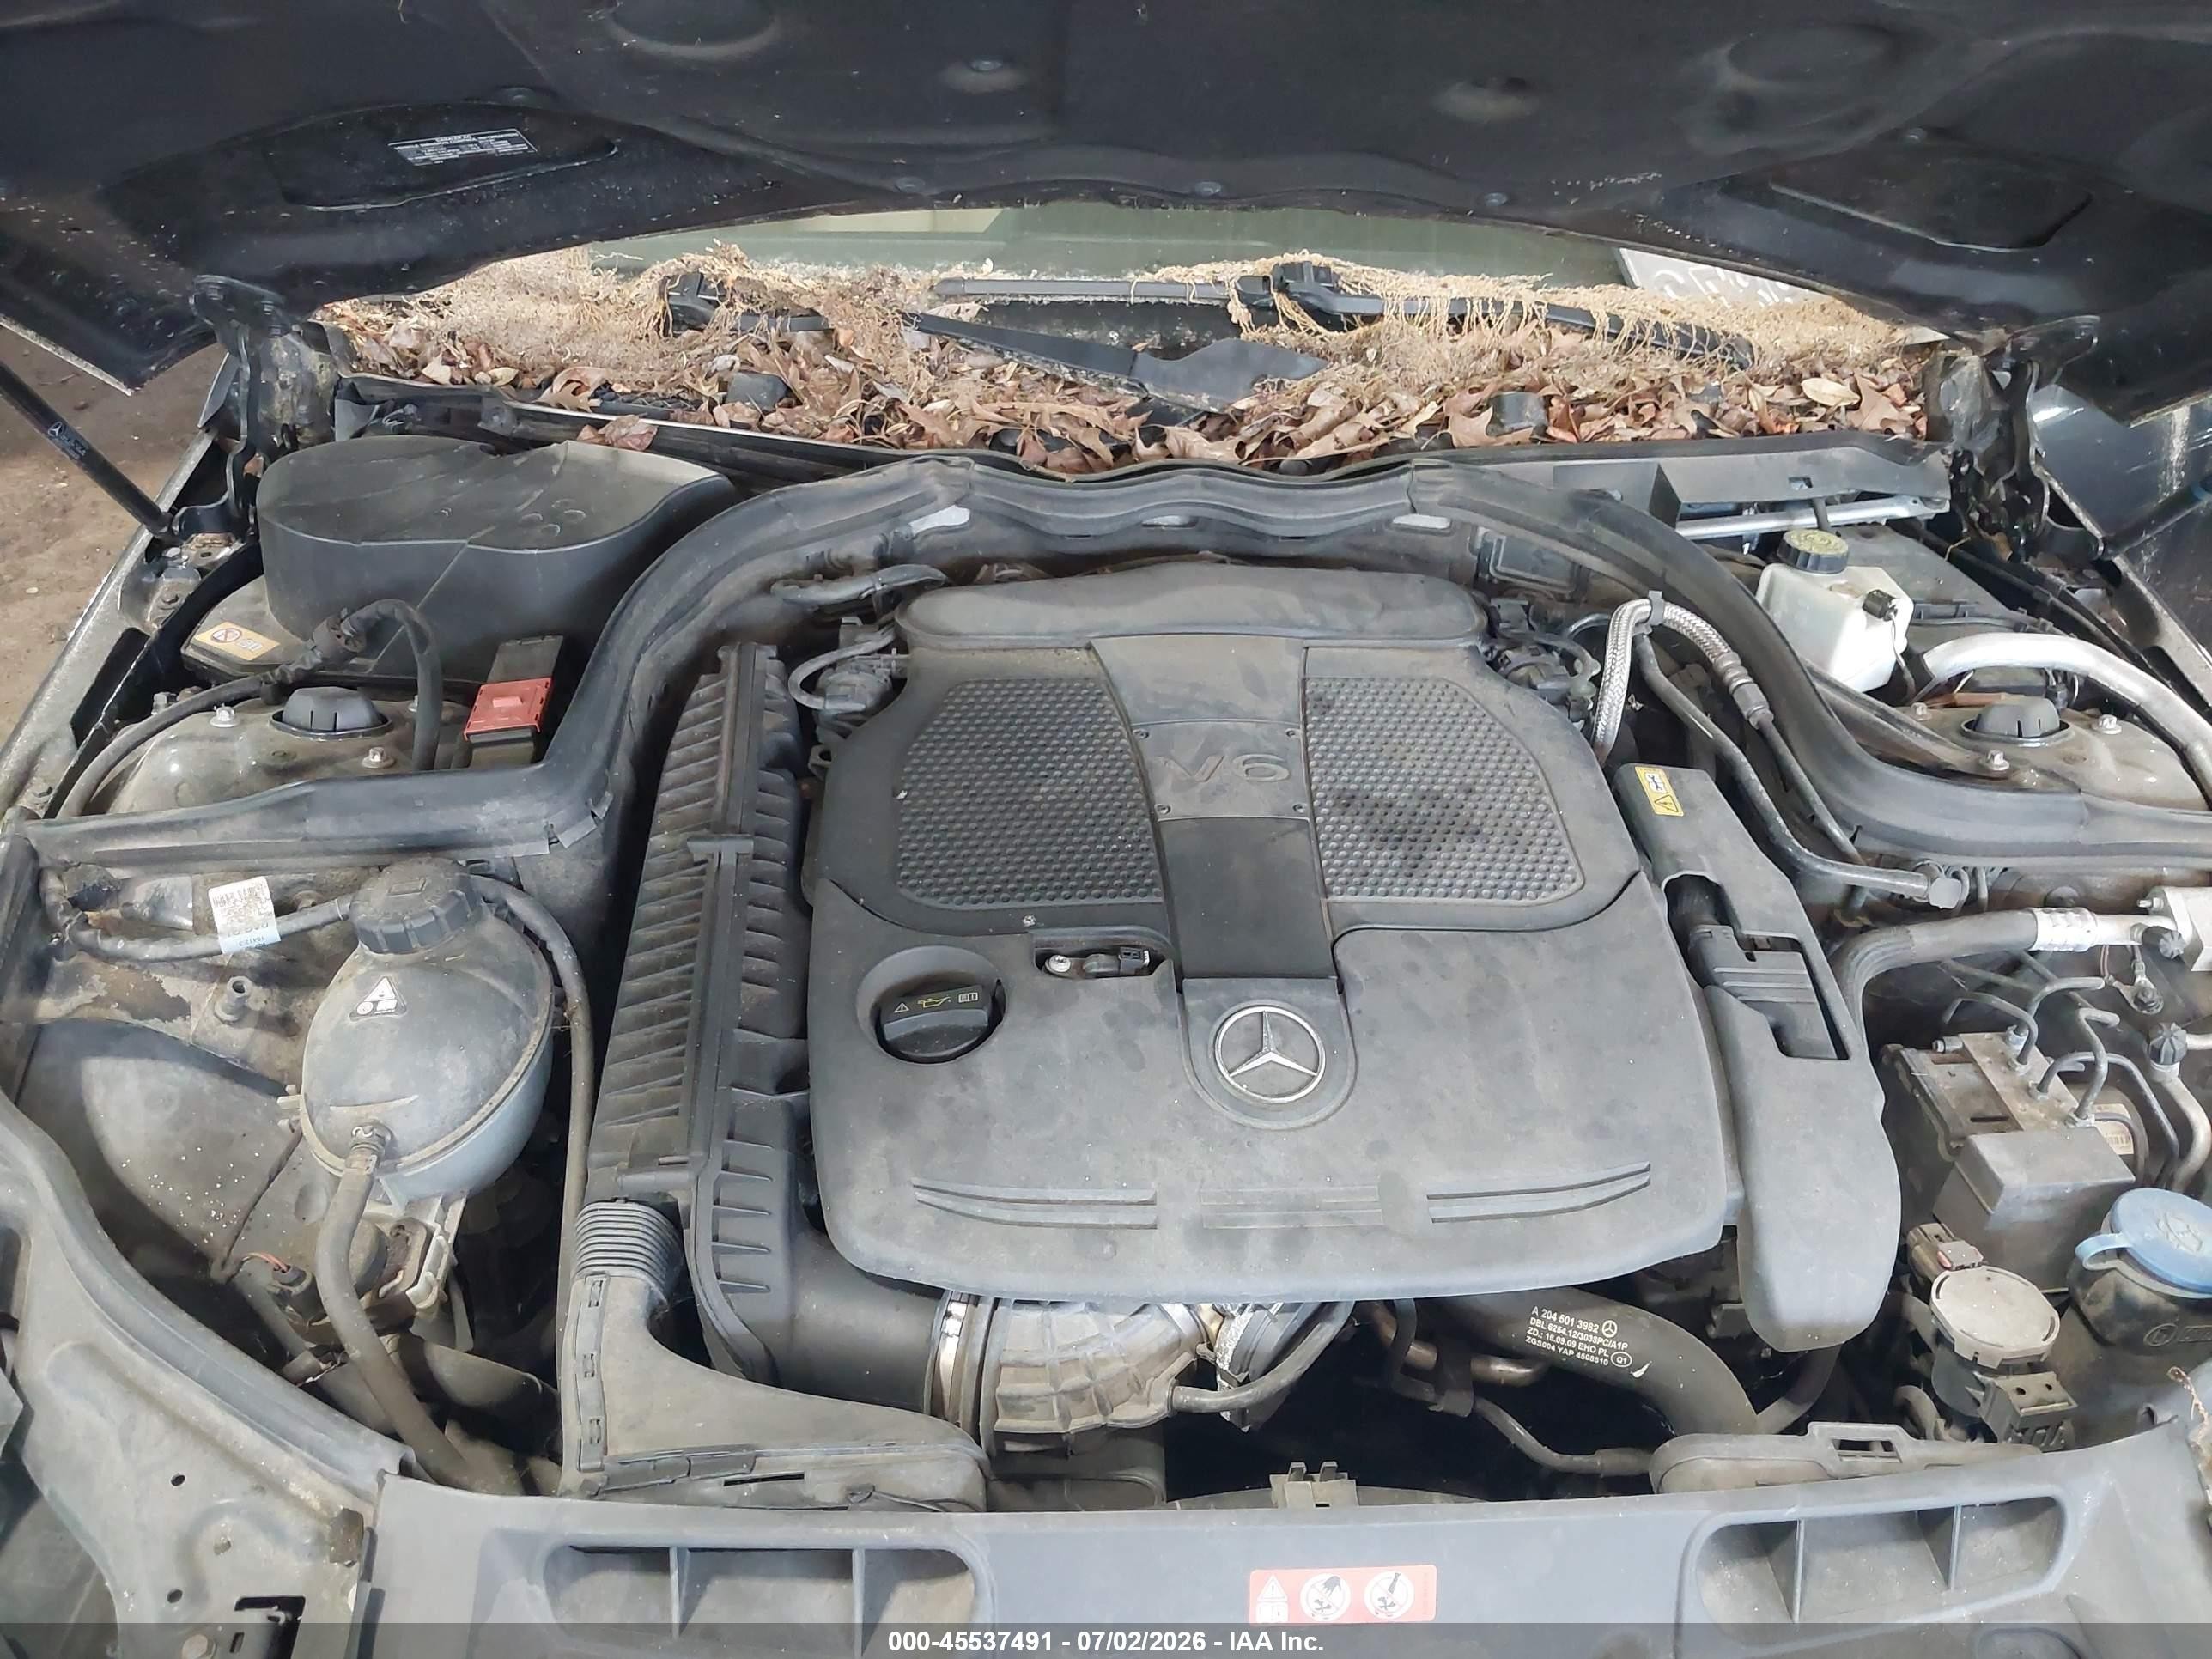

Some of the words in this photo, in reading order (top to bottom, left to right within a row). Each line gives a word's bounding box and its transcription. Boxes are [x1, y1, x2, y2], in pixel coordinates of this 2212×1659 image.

[1153, 753, 1291, 783] V6
[1529, 1316, 1547, 1330] DBL
[1531, 1305, 1540, 1316] A
[1540, 1308, 1558, 1322] 204
[1559, 1312, 1576, 1326] 501
[1577, 1317, 1600, 1334] 3982
[1557, 1345, 1575, 1358] YAP
[1577, 1340, 1597, 1354] EHO
[1597, 1346, 1610, 1358] PL
[1616, 1356, 1628, 1364] Q1
